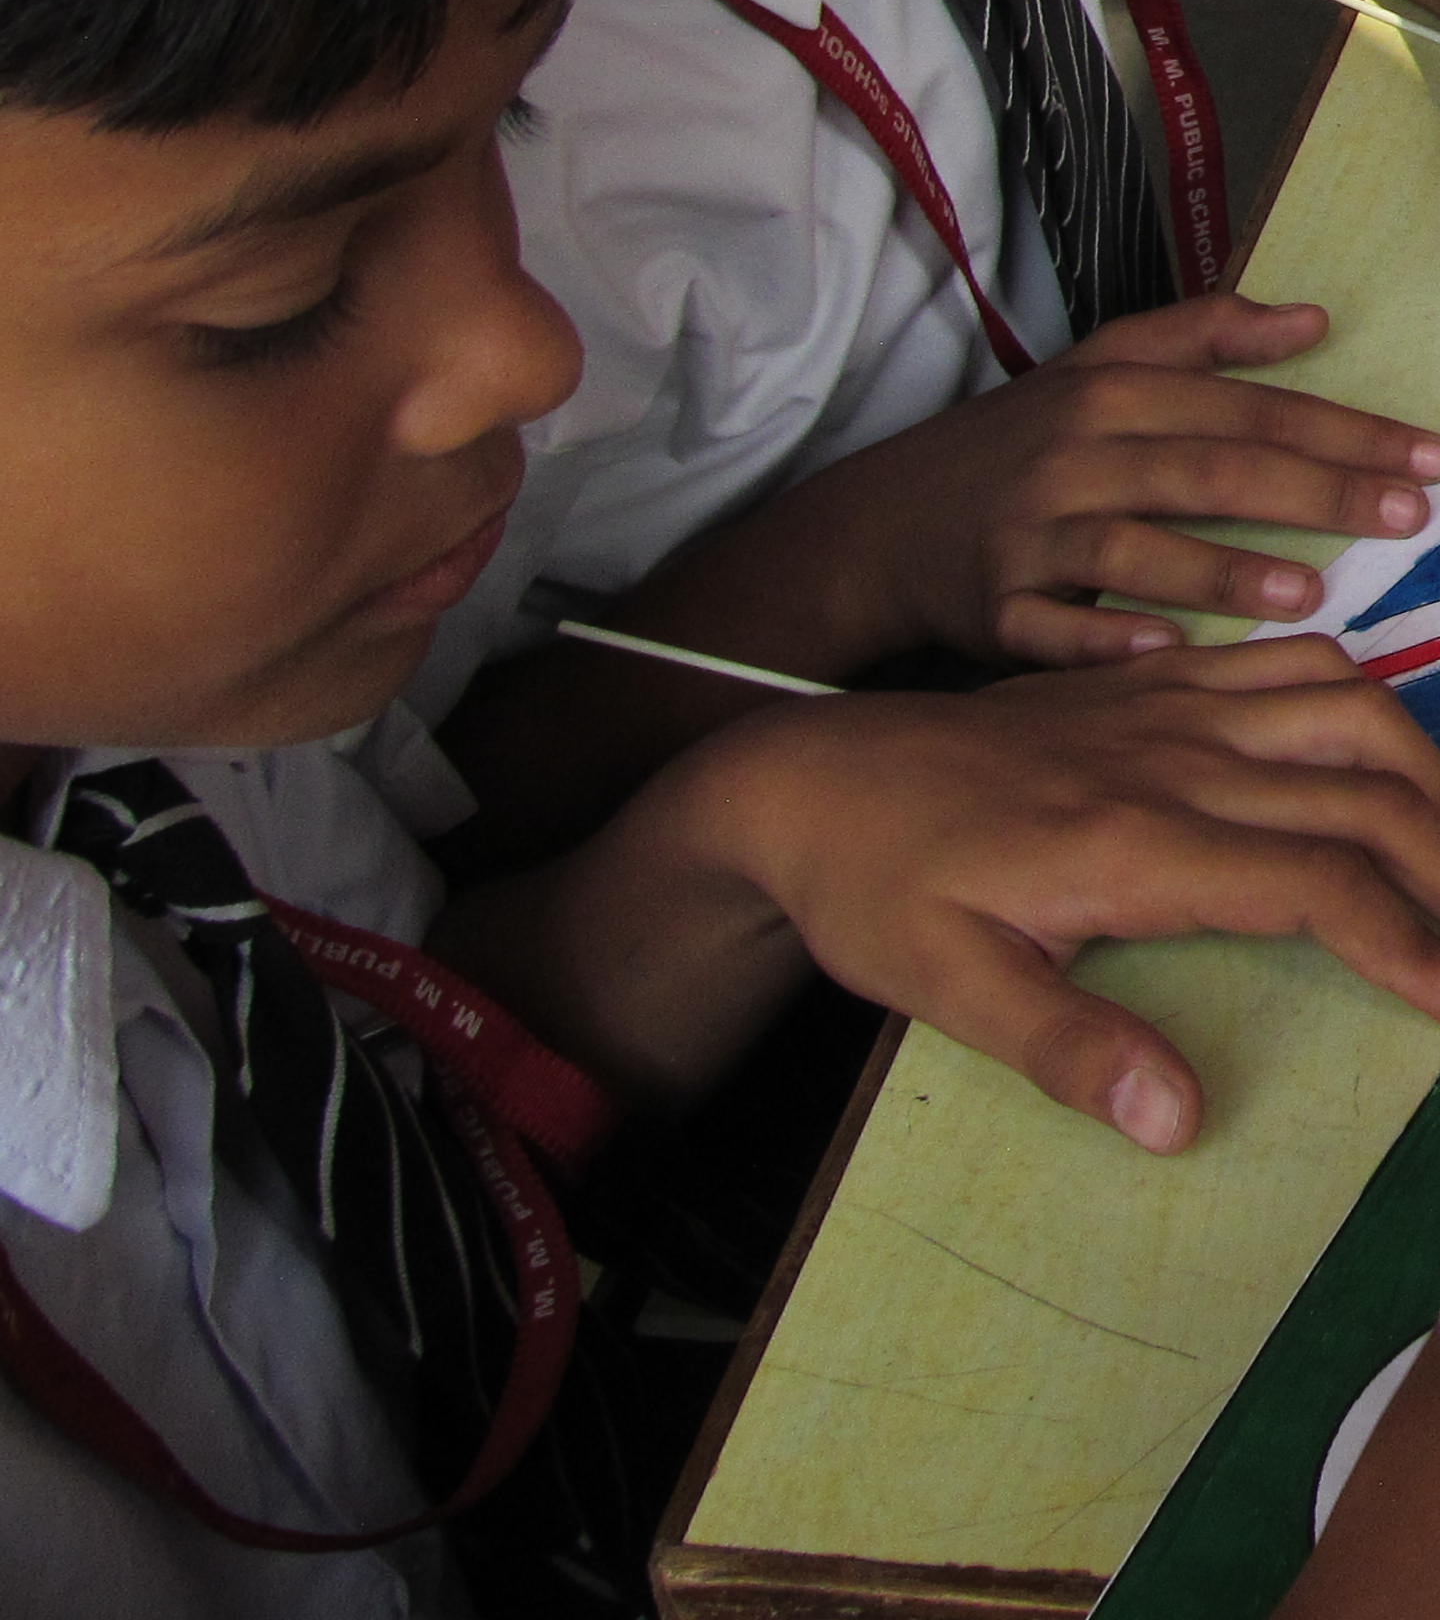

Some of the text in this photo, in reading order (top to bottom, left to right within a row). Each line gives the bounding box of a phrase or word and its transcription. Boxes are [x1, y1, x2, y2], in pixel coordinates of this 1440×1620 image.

[819, 25, 889, 116] SCHOOL
[1147, 27, 1219, 290] M. M. PUBLIC SCHOOL
[412, 972, 443, 1009] M.
[451, 1000, 484, 1040] M.
[527, 1229, 550, 1269] M.
[534, 1276, 556, 1320] M.
